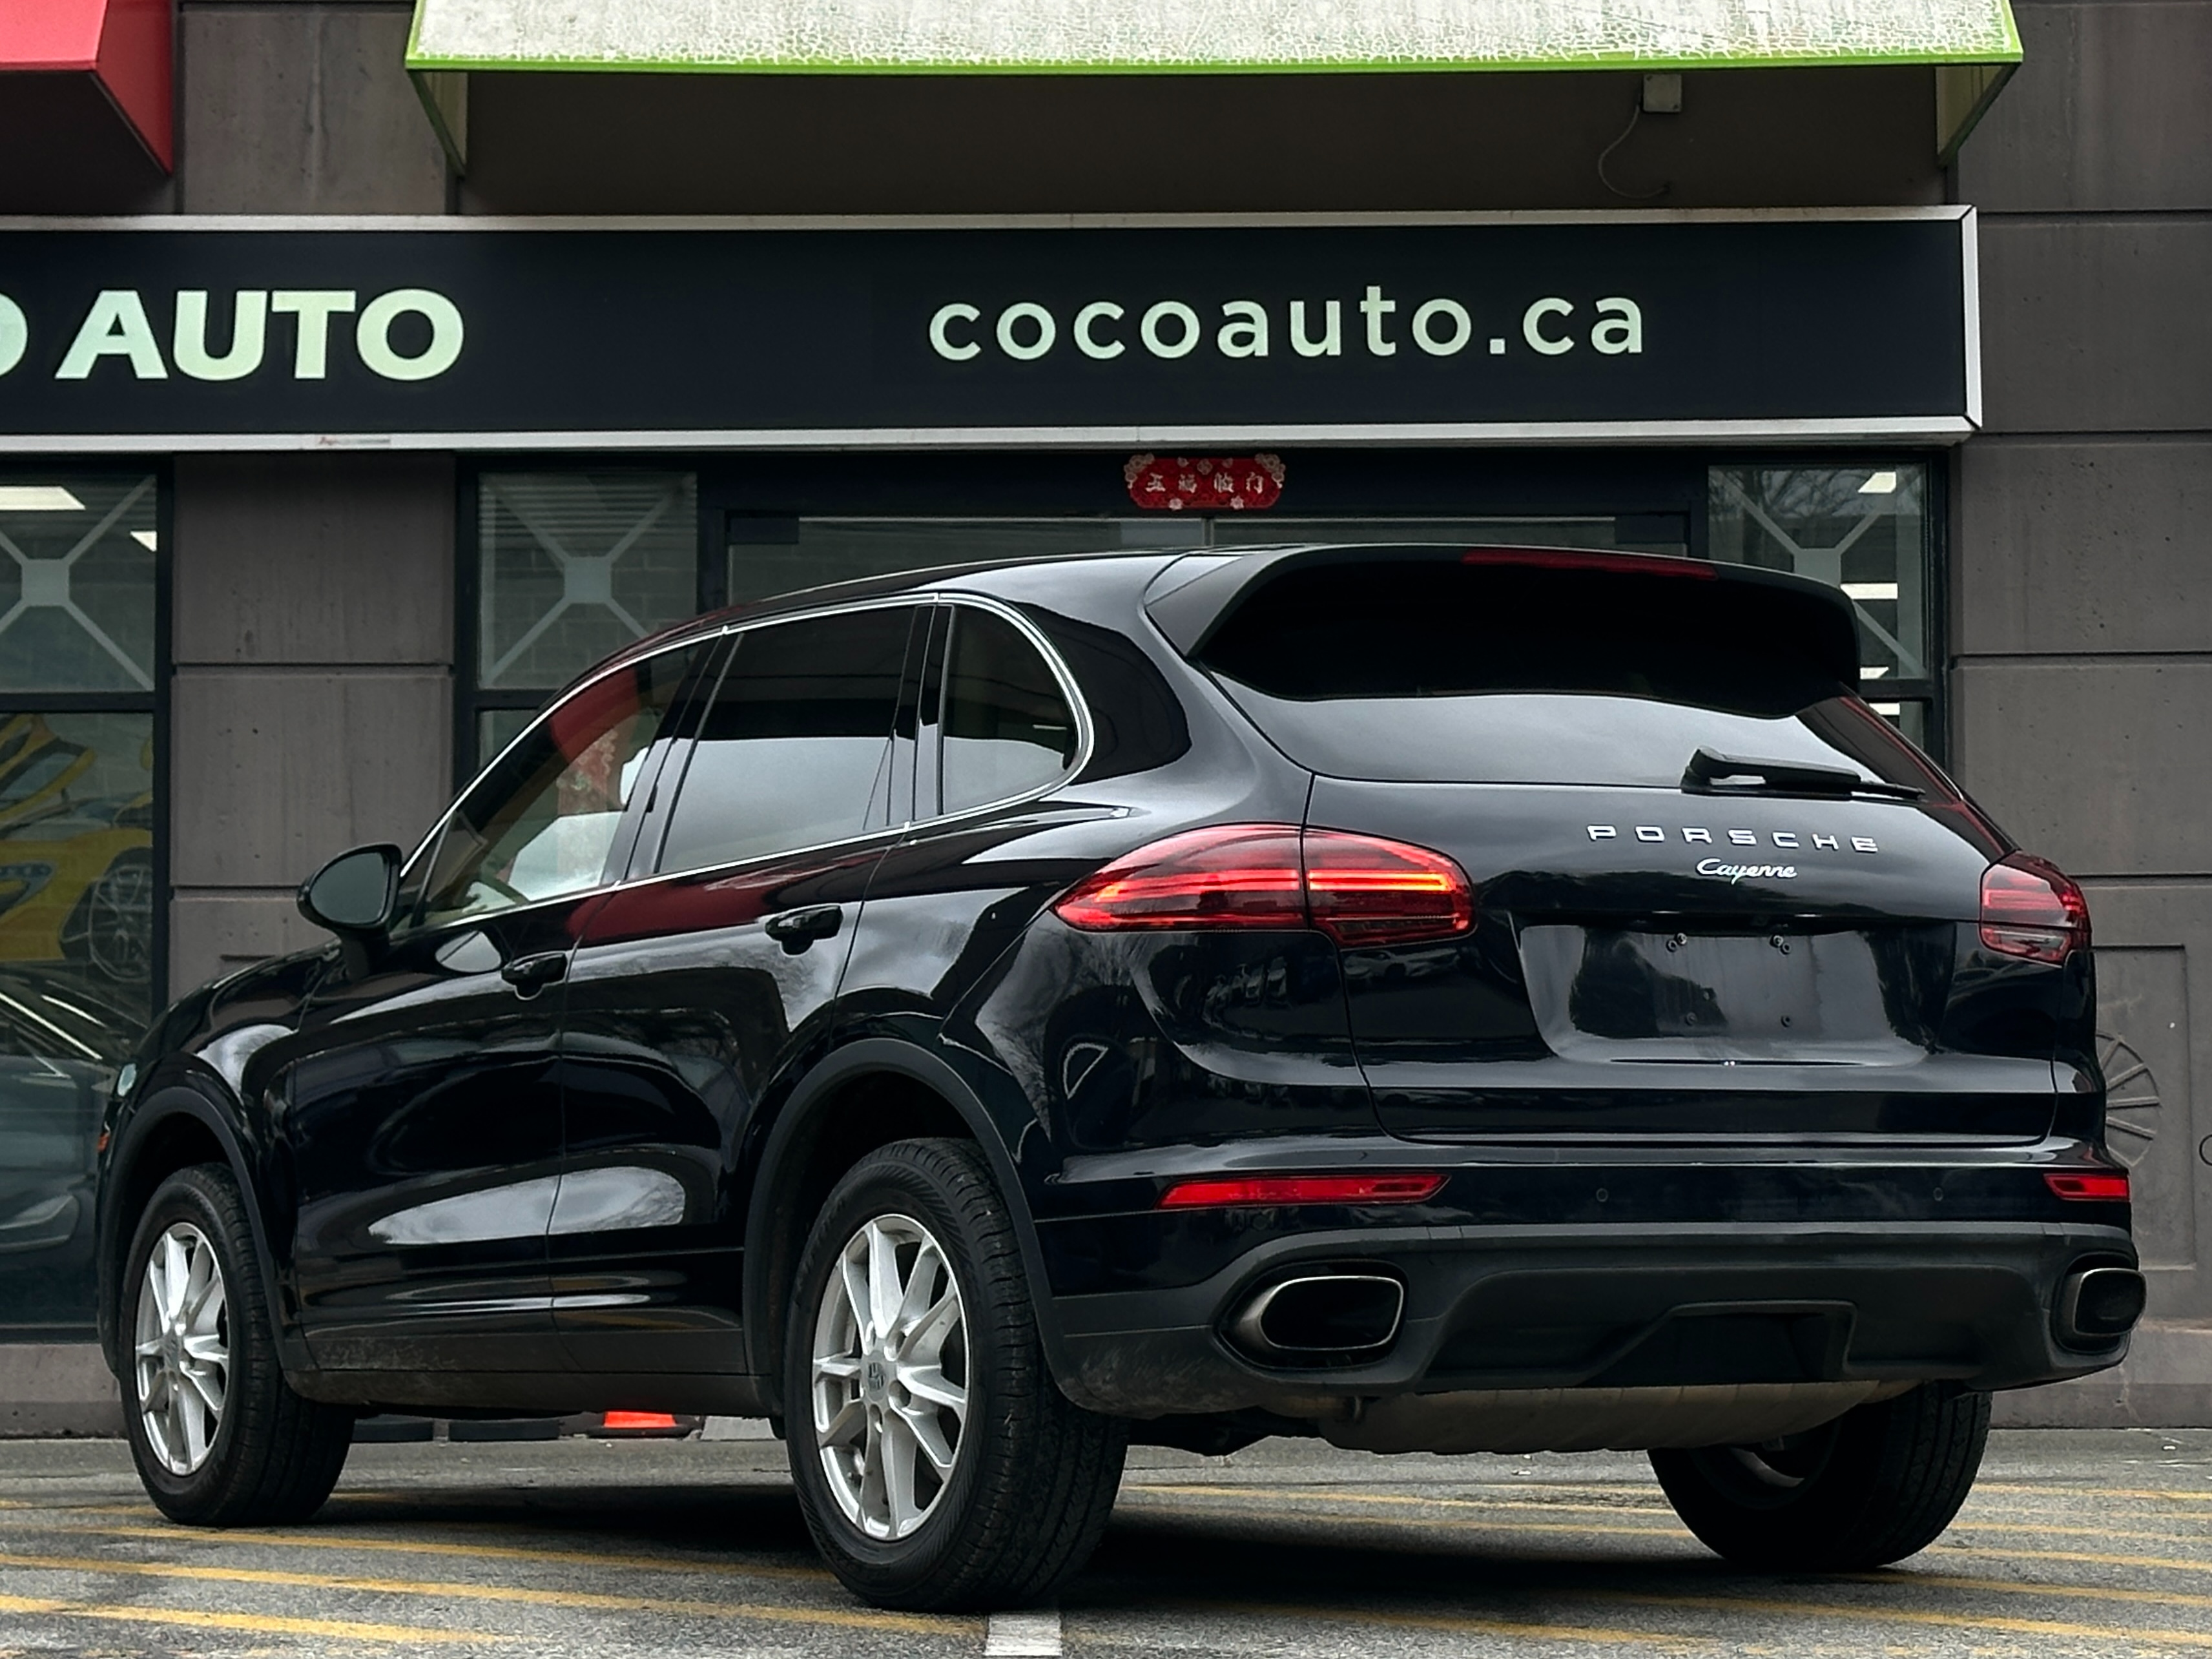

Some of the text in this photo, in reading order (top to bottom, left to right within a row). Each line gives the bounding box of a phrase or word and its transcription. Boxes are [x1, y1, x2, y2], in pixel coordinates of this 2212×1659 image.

[55, 289, 464, 381] AUTO
[929, 285, 1644, 360] cocoauto.ca
[1586, 825, 1879, 852] PORSCHE
[1695, 858, 1798, 885] Cayenne
